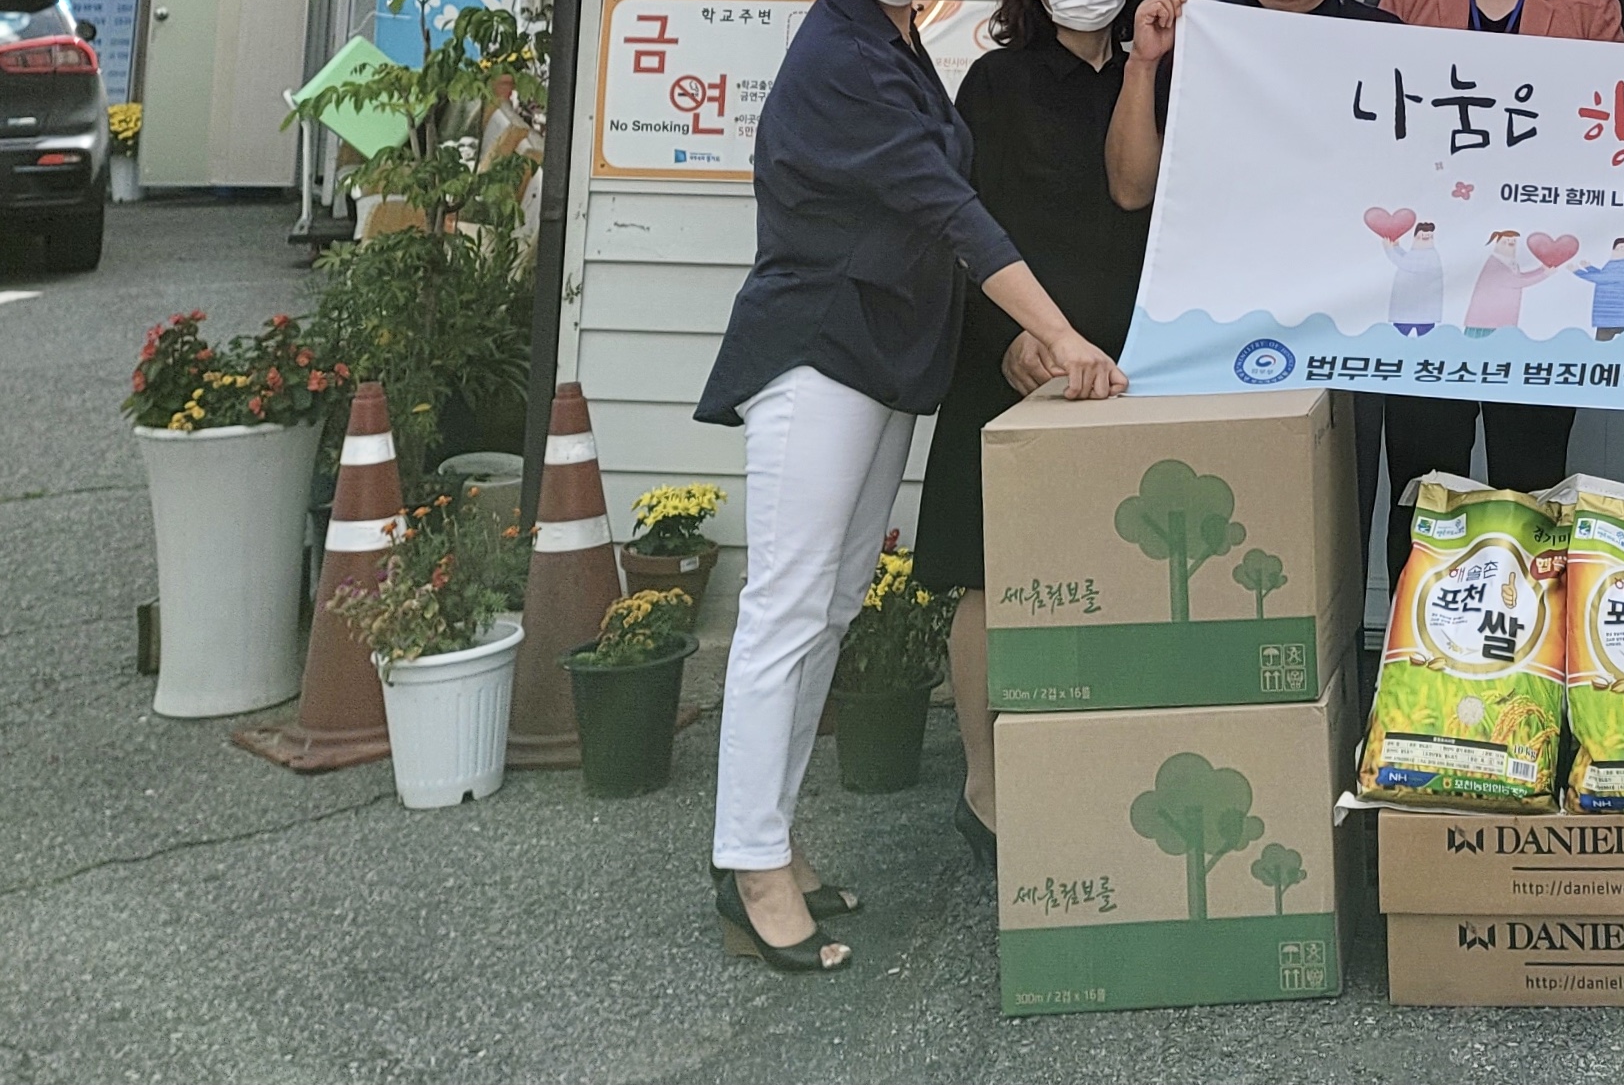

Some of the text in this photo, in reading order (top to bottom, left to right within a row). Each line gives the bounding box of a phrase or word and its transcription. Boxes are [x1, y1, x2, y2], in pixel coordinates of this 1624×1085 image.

[740, 92, 768, 102] 금연구
[1353, 64, 1540, 155] 나눔은
[609, 120, 690, 135] No Smoking
[1500, 183, 1560, 205] 이웃과
[1565, 188, 1605, 207] 함께
[1306, 355, 1403, 381] 법무부
[1413, 360, 1510, 386] 청소년
[1432, 583, 1487, 613] 포천
[1478, 610, 1525, 663] 쌀
[1389, 773, 1407, 782] NH
